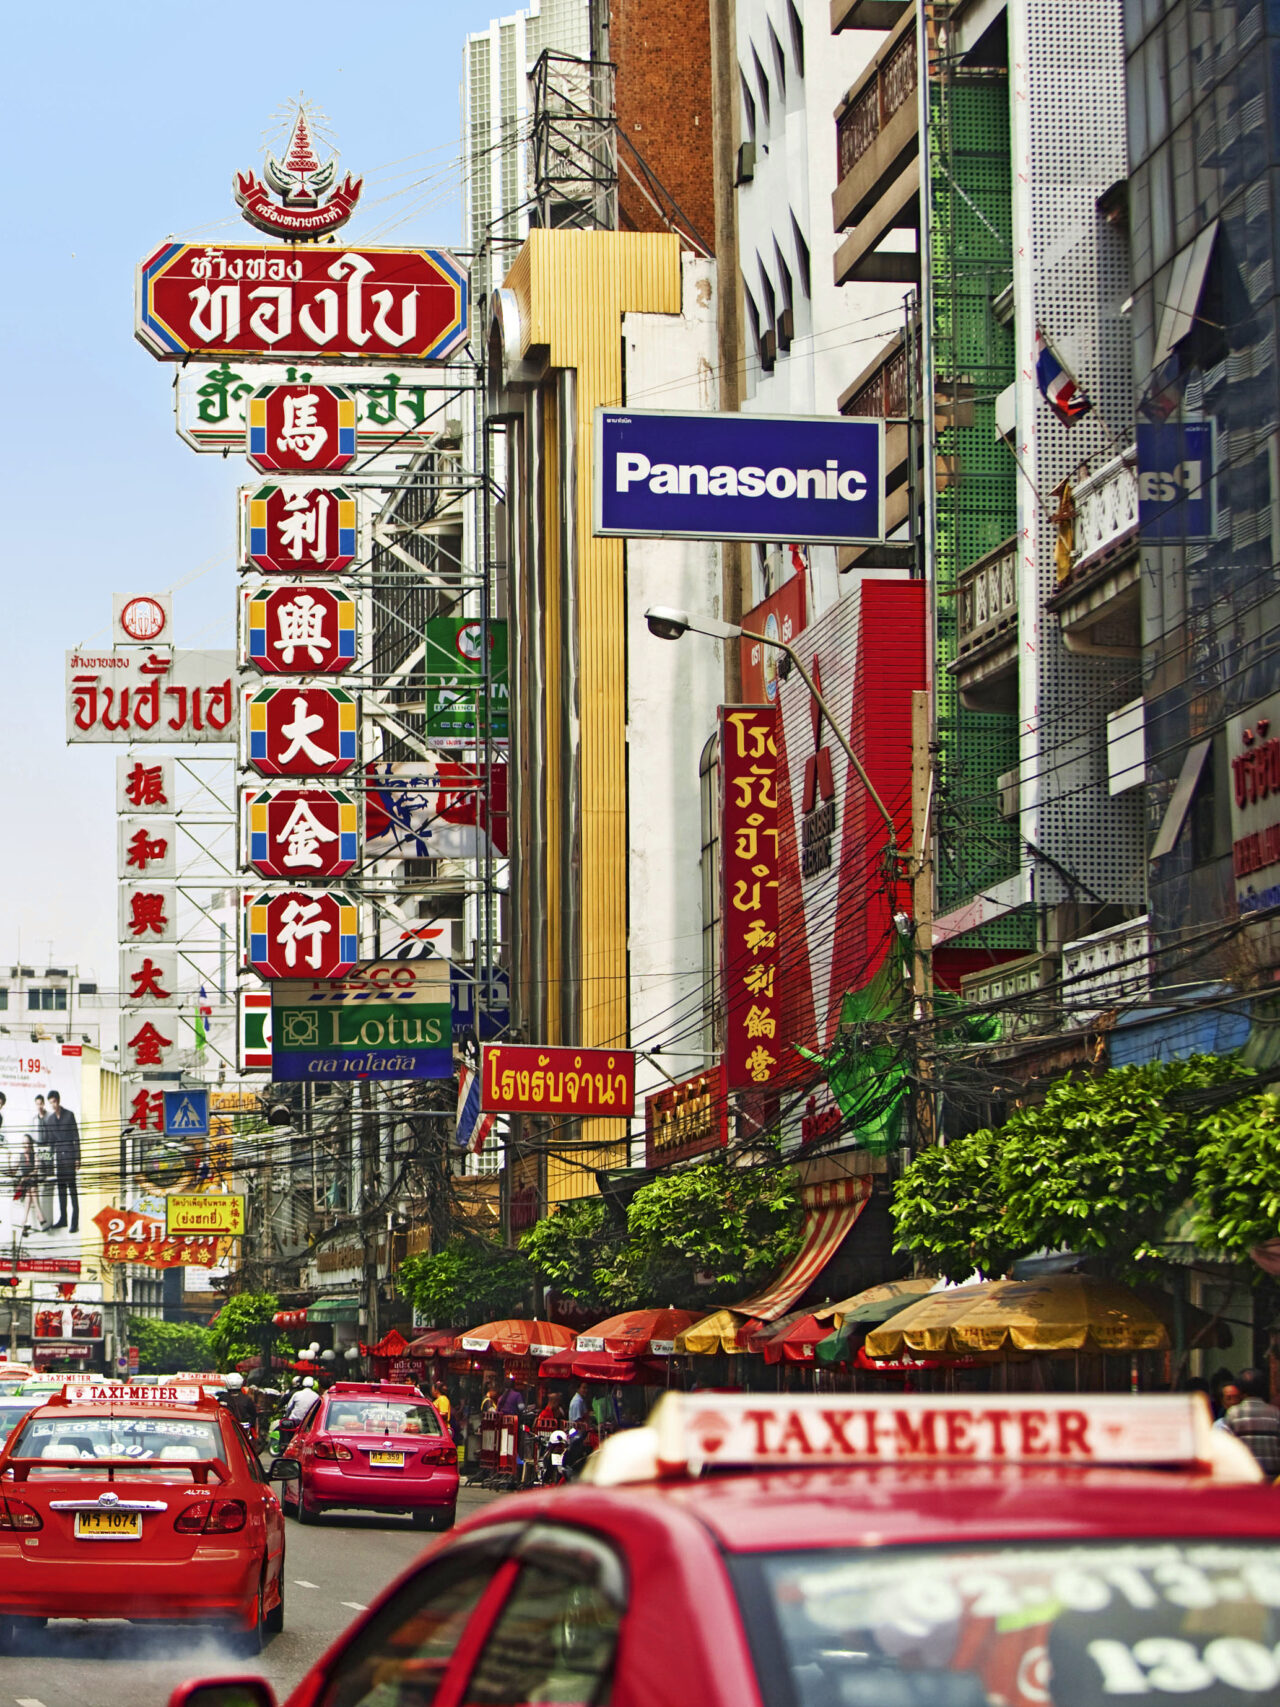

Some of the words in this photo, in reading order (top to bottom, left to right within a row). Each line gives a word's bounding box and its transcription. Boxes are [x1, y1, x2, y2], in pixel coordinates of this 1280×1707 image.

[255, 203, 343, 228] เครื่องหมายการค้า
[190, 248, 303, 281] ห้างทอง
[188, 253, 420, 348] ทองใบ
[616, 452, 867, 501] Panasonic
[329, 1010, 442, 1046] Lotus
[18, 1058, 41, 1073] 1.99
[307, 1052, 416, 1073] ตลาดโลตัส
[488, 1049, 627, 1105] โรงรับจำนำ
[90, 1385, 178, 1400] TAXI-METER
[744, 1409, 1095, 1457] TAXI-METER
[106, 1512, 137, 1529] 1074
[1087, 1636, 1280, 1694] 130
